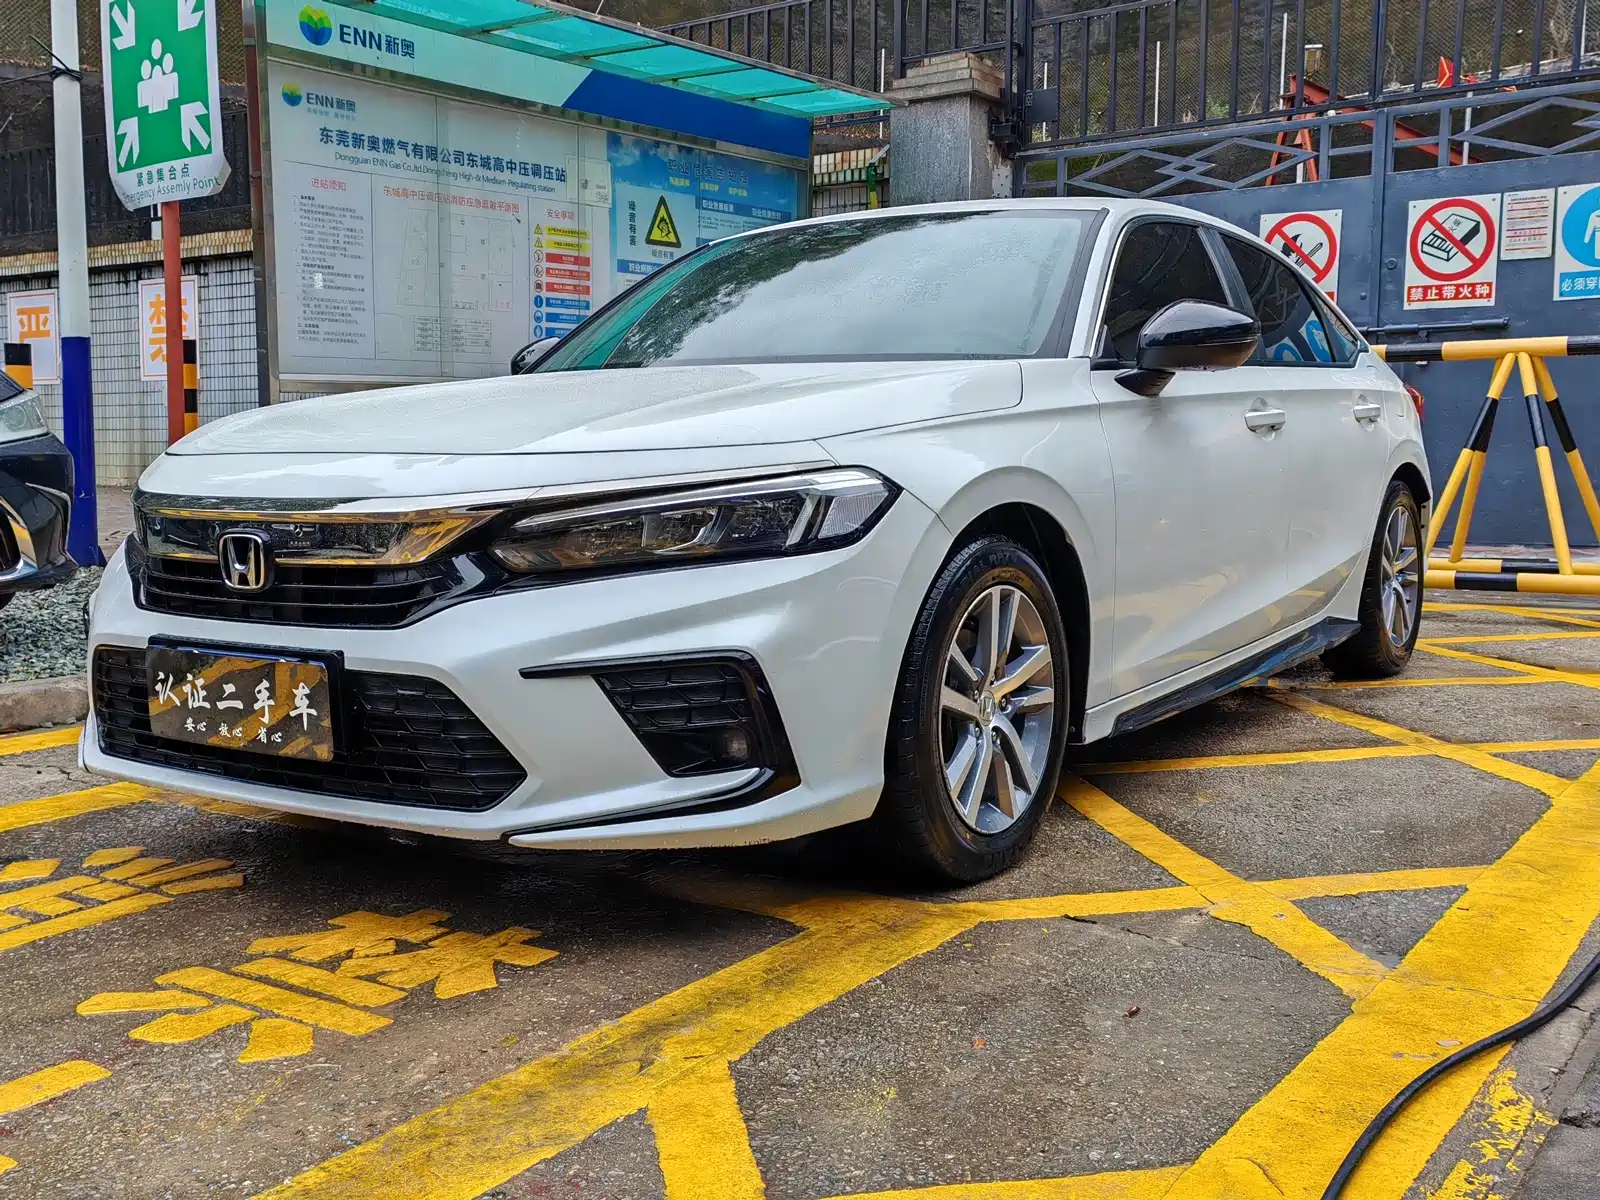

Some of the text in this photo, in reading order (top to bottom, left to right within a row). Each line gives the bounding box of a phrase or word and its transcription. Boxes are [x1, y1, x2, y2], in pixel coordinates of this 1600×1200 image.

[319, 126, 568, 184] 东莞新奥燃气有限公司东城高中压调压站
[335, 151, 372, 166] Dongguan
[373, 157, 388, 168] ENN
[389, 160, 402, 170] Gas
[136, 162, 190, 187] 紧急集合点
[193, 176, 221, 190] Point
[311, 178, 347, 192] 进站须知
[1409, 284, 1490, 300] 禁止带火种
[1561, 276, 1600, 291] 必须穿
[155, 671, 318, 732] 认证二手车
[184, 716, 283, 744] 安心 放心 省心
